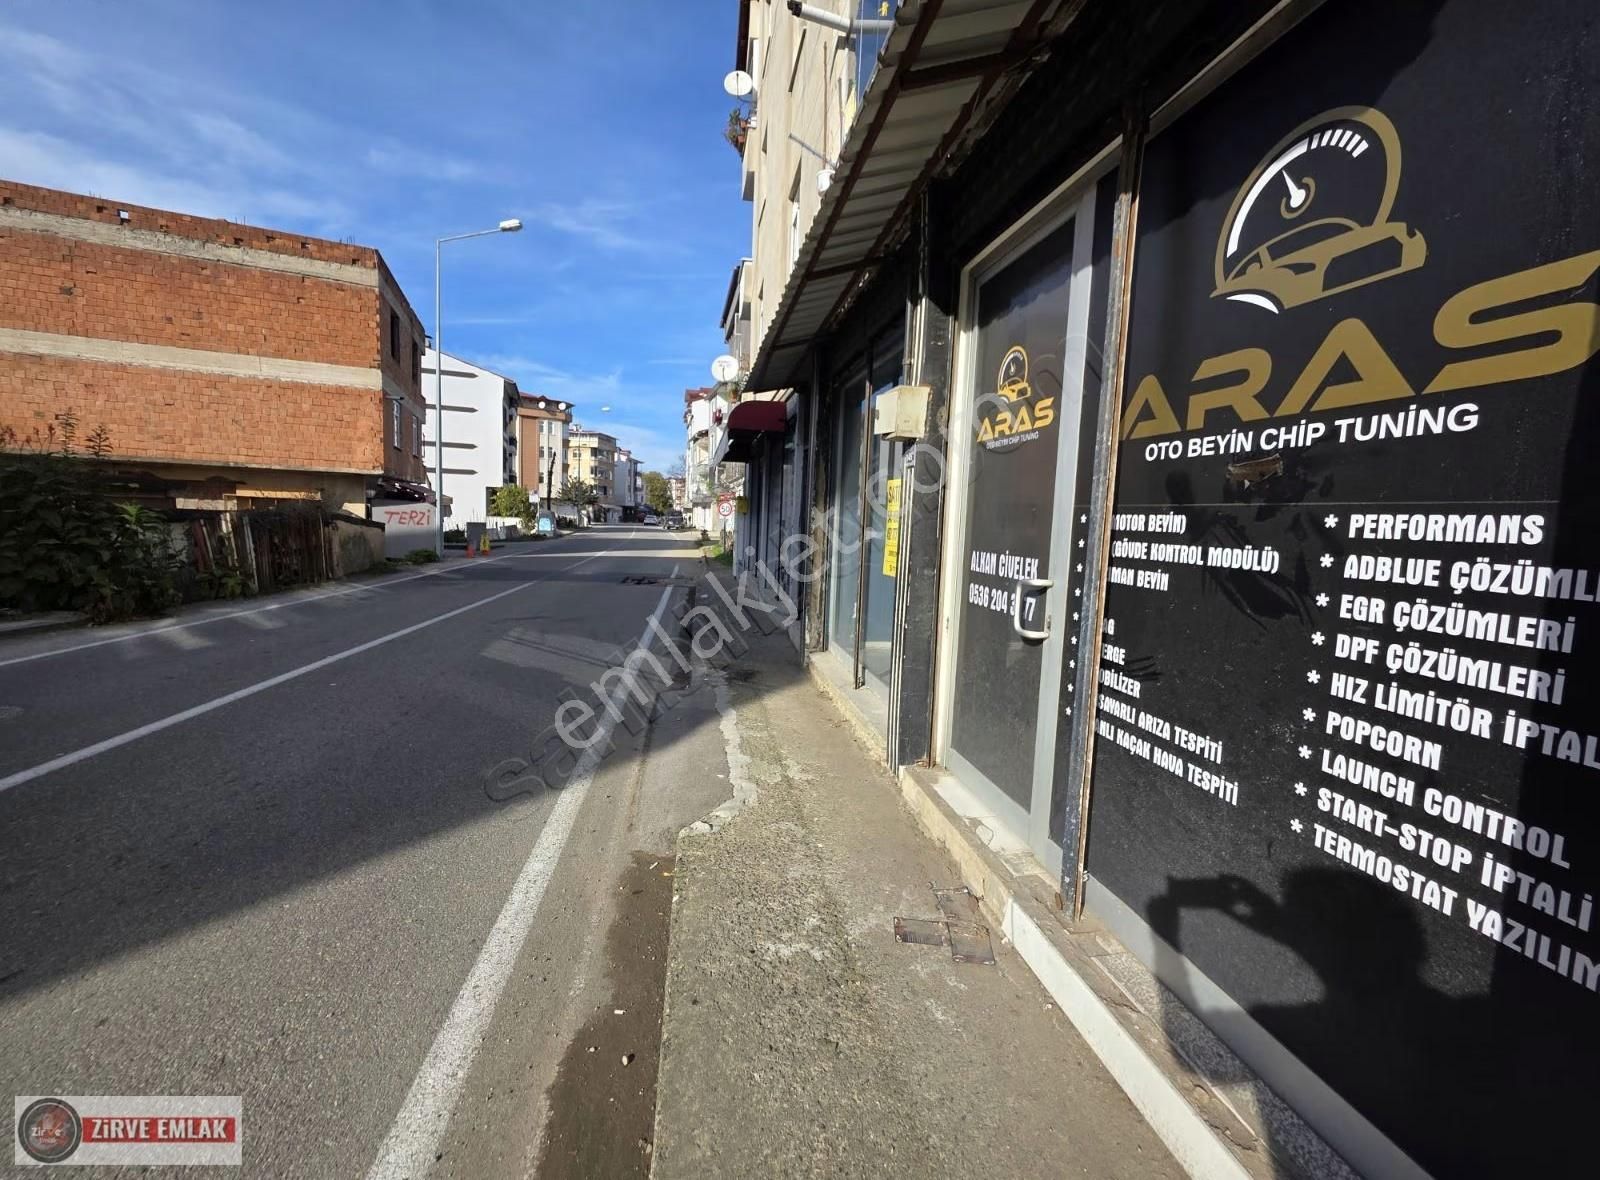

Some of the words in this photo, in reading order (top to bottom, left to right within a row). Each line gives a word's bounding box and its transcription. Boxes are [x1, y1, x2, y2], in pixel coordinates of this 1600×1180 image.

[1123, 250, 1600, 440] ARAS
[977, 397, 1055, 442] ARAS
[1144, 441, 1183, 462] OTO
[1187, 428, 1253, 458] BEYİN
[1259, 419, 1326, 451] CHİP
[1334, 403, 1480, 444] TUNİNG
[1150, 543, 1204, 565] KONTROL
[1207, 545, 1280, 574] MODÜLÜ)
[1348, 513, 1545, 545] PERFORMANS
[970, 550, 997, 575] ALKAN
[1137, 569, 1169, 592] BEYİN
[1343, 554, 1441, 587] ADBLUE
[969, 583, 989, 608] 0536
[990, 588, 1009, 614] 204
[1339, 594, 1385, 624] EGR
[1392, 598, 1576, 653] ÇÖZÜMLERİ
[1334, 633, 1380, 664] DPF
[1386, 642, 1565, 705] ÇÖZÜMLERİ
[1330, 672, 1369, 704] HIZ
[1374, 681, 1493, 739] LİMİTÖR
[1116, 728, 1151, 759] KAÇAK
[1153, 745, 1184, 778] HAVA
[1187, 763, 1239, 806] TESPİTİ
[1138, 716, 1171, 740] ARIZA
[1174, 725, 1222, 765] TESPİTİ
[1326, 711, 1442, 771] POPCORN
[1321, 748, 1416, 807] LAUNCH
[1423, 787, 1570, 870] CONTROL
[1313, 823, 1458, 917] TERMOSTAT
[1317, 787, 1473, 873] START-STOP
[1480, 851, 1593, 932] İPTALİ
